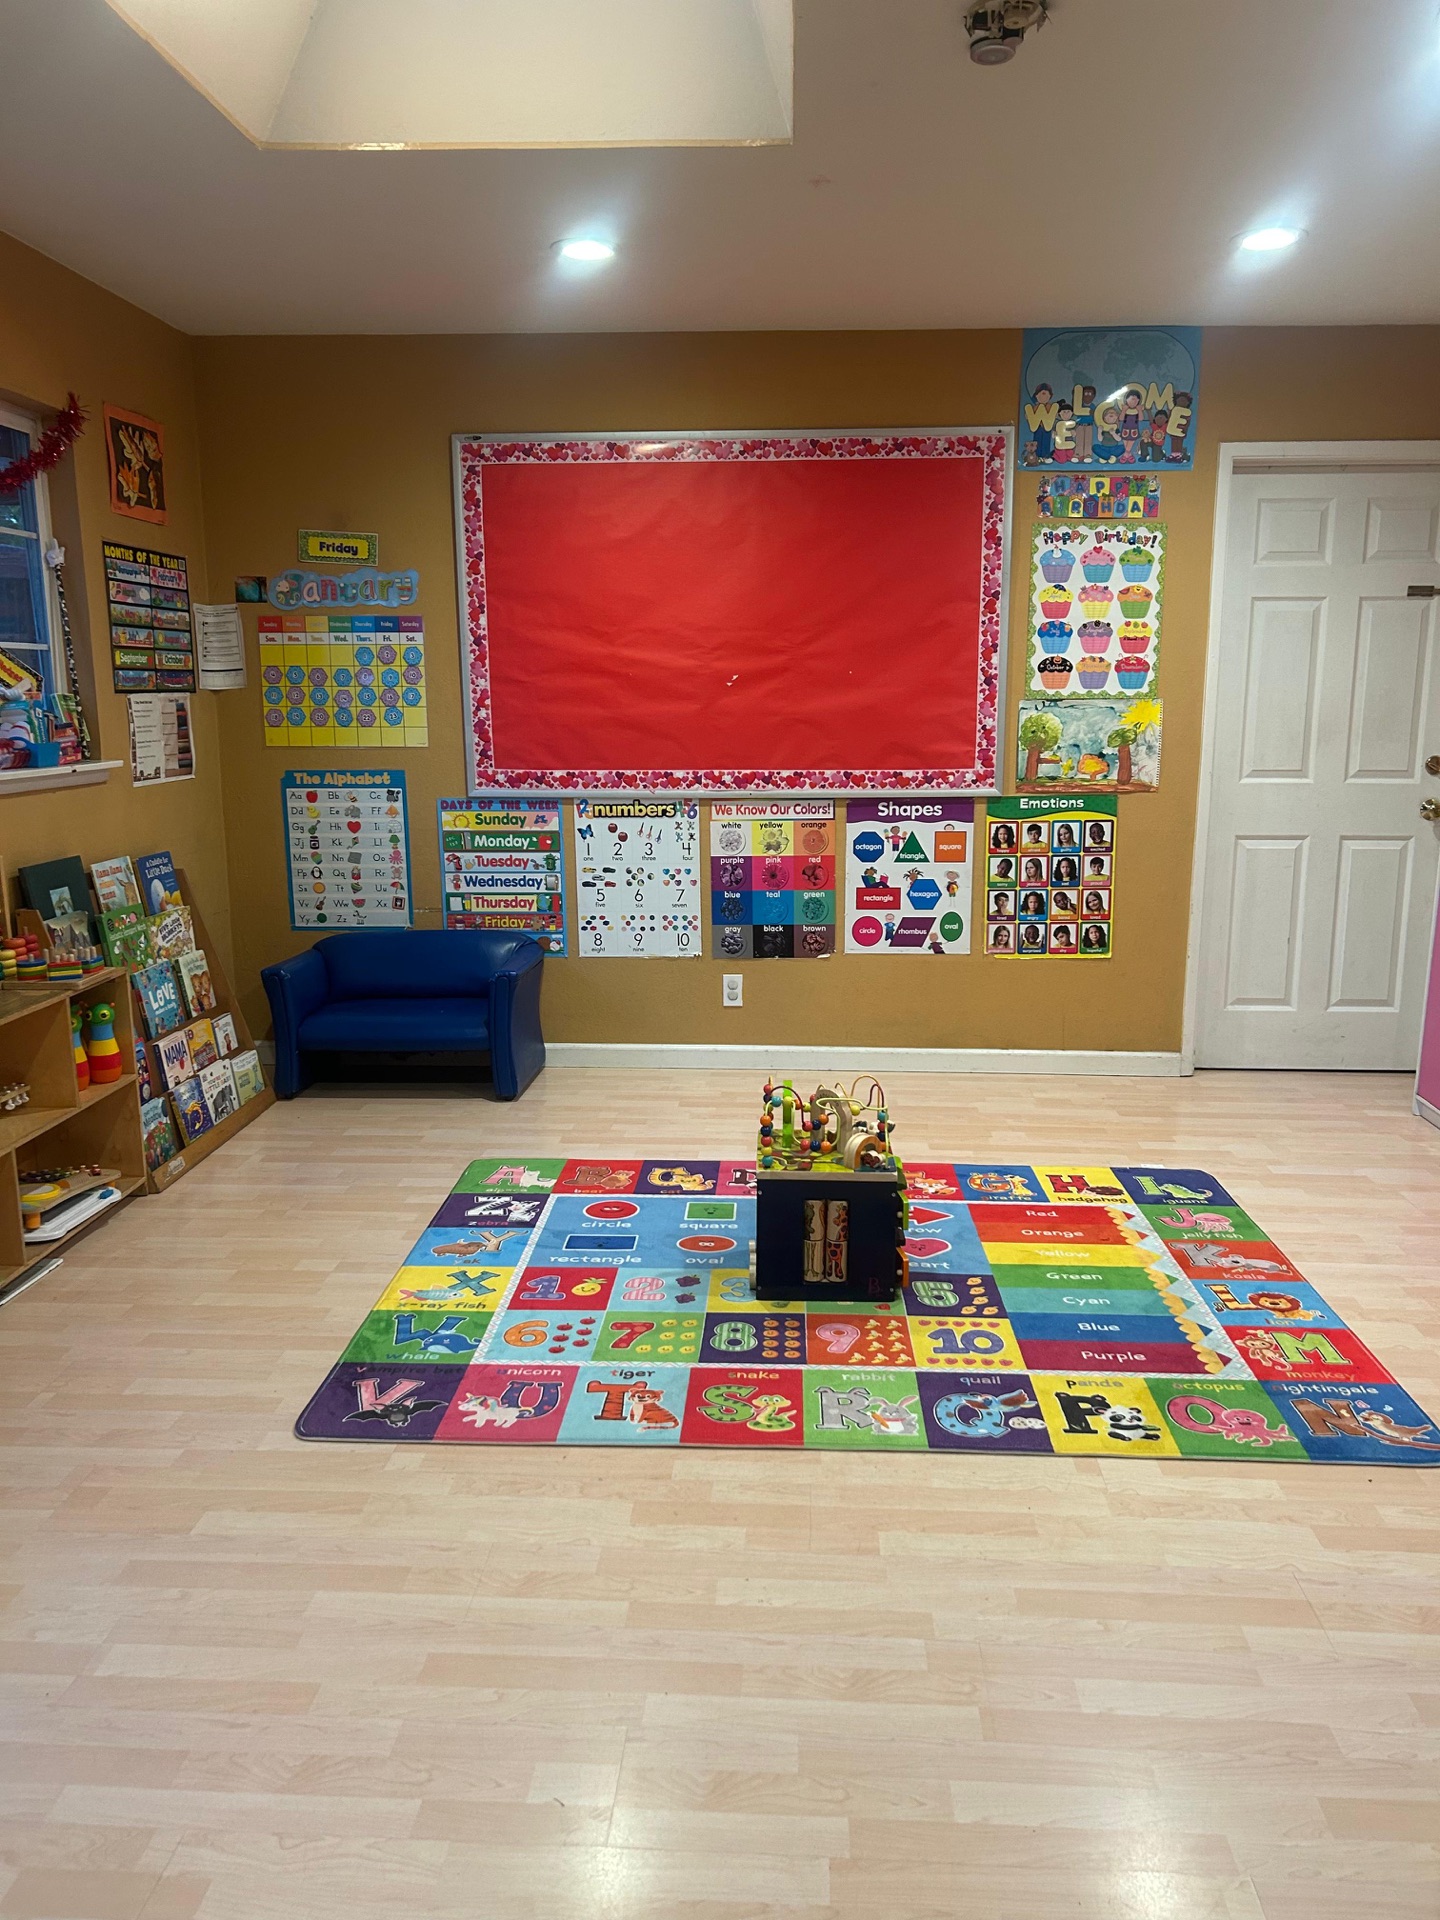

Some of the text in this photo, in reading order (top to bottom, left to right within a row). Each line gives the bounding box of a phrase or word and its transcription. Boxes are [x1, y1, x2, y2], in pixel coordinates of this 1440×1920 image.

[1025, 382, 1192, 450] WELCOME
[1054, 480, 1144, 494] HAPPY
[1041, 498, 1157, 514] BIRTHDAY
[1043, 529, 1157, 548] Happy Birthday!
[319, 542, 358, 556] Friday
[104, 545, 178, 570] MONTHS OF THE YEAR
[120, 652, 148, 664] September
[165, 655, 184, 665] October
[294, 772, 391, 786] The Alphabet
[440, 800, 559, 810] DAYS OF THE WEEK
[593, 800, 675, 818] numbers
[715, 803, 831, 816] We Know Our Colors!
[1020, 798, 1084, 809] Emotions
[878, 802, 943, 819] Shapes
[475, 813, 527, 828] Sunday
[474, 835, 529, 849] Monday
[614, 842, 622, 855] 2
[682, 842, 691, 855] 4
[587, 843, 590, 856] 1
[645, 842, 653, 856] 3
[475, 855, 529, 870] Tuesday
[721, 857, 744, 865] purple
[146, 864, 173, 878] Little Duck
[464, 876, 543, 890] Wednesday
[597, 889, 605, 901] 5
[635, 889, 643, 901] 6
[676, 889, 685, 901] 7
[473, 896, 535, 911] Thursday
[485, 916, 526, 929] Friday
[594, 933, 602, 946] 8
[634, 933, 643, 946] 9
[677, 935, 689, 946] 10
[148, 982, 175, 1010] LOVE
[164, 1040, 188, 1067] MAMA
[1046, 1175, 1090, 1194] H
[1058, 1196, 1128, 1204] hedgehog
[581, 1220, 632, 1229] circle
[679, 1222, 739, 1231] square
[908, 1226, 943, 1234] row
[1021, 1229, 1084, 1238] Orange
[549, 1254, 642, 1265] rectangle
[685, 1256, 725, 1265] oval
[1037, 1250, 1090, 1258] Yellow
[908, 1261, 950, 1269] eart
[1046, 1272, 1103, 1280] Green
[519, 1275, 566, 1300] 1
[621, 1277, 666, 1302] 2
[911, 1280, 960, 1307] 5
[397, 1301, 486, 1311] x-ray fish
[1062, 1297, 1111, 1306] Cyan
[1078, 1322, 1121, 1331] Blue
[1265, 1318, 1295, 1326] lion
[503, 1319, 549, 1348] 6
[609, 1321, 656, 1350] 7
[709, 1321, 759, 1351] 8
[815, 1323, 861, 1353] 9
[927, 1327, 1004, 1355] 10
[1269, 1332, 1352, 1365] M
[386, 1351, 440, 1361] whale
[1081, 1351, 1147, 1363] Purple
[496, 1368, 561, 1376] unicorn
[611, 1369, 655, 1379] tiger
[842, 1372, 897, 1382] rabbit
[1286, 1371, 1356, 1382] monkey
[960, 1375, 1001, 1386] quail
[1066, 1378, 1124, 1390] panda
[1173, 1383, 1245, 1392] octopus
[1272, 1384, 1379, 1396] nightingale
[698, 1384, 759, 1423] S
[814, 1386, 874, 1431] R
[1289, 1398, 1368, 1437] N
